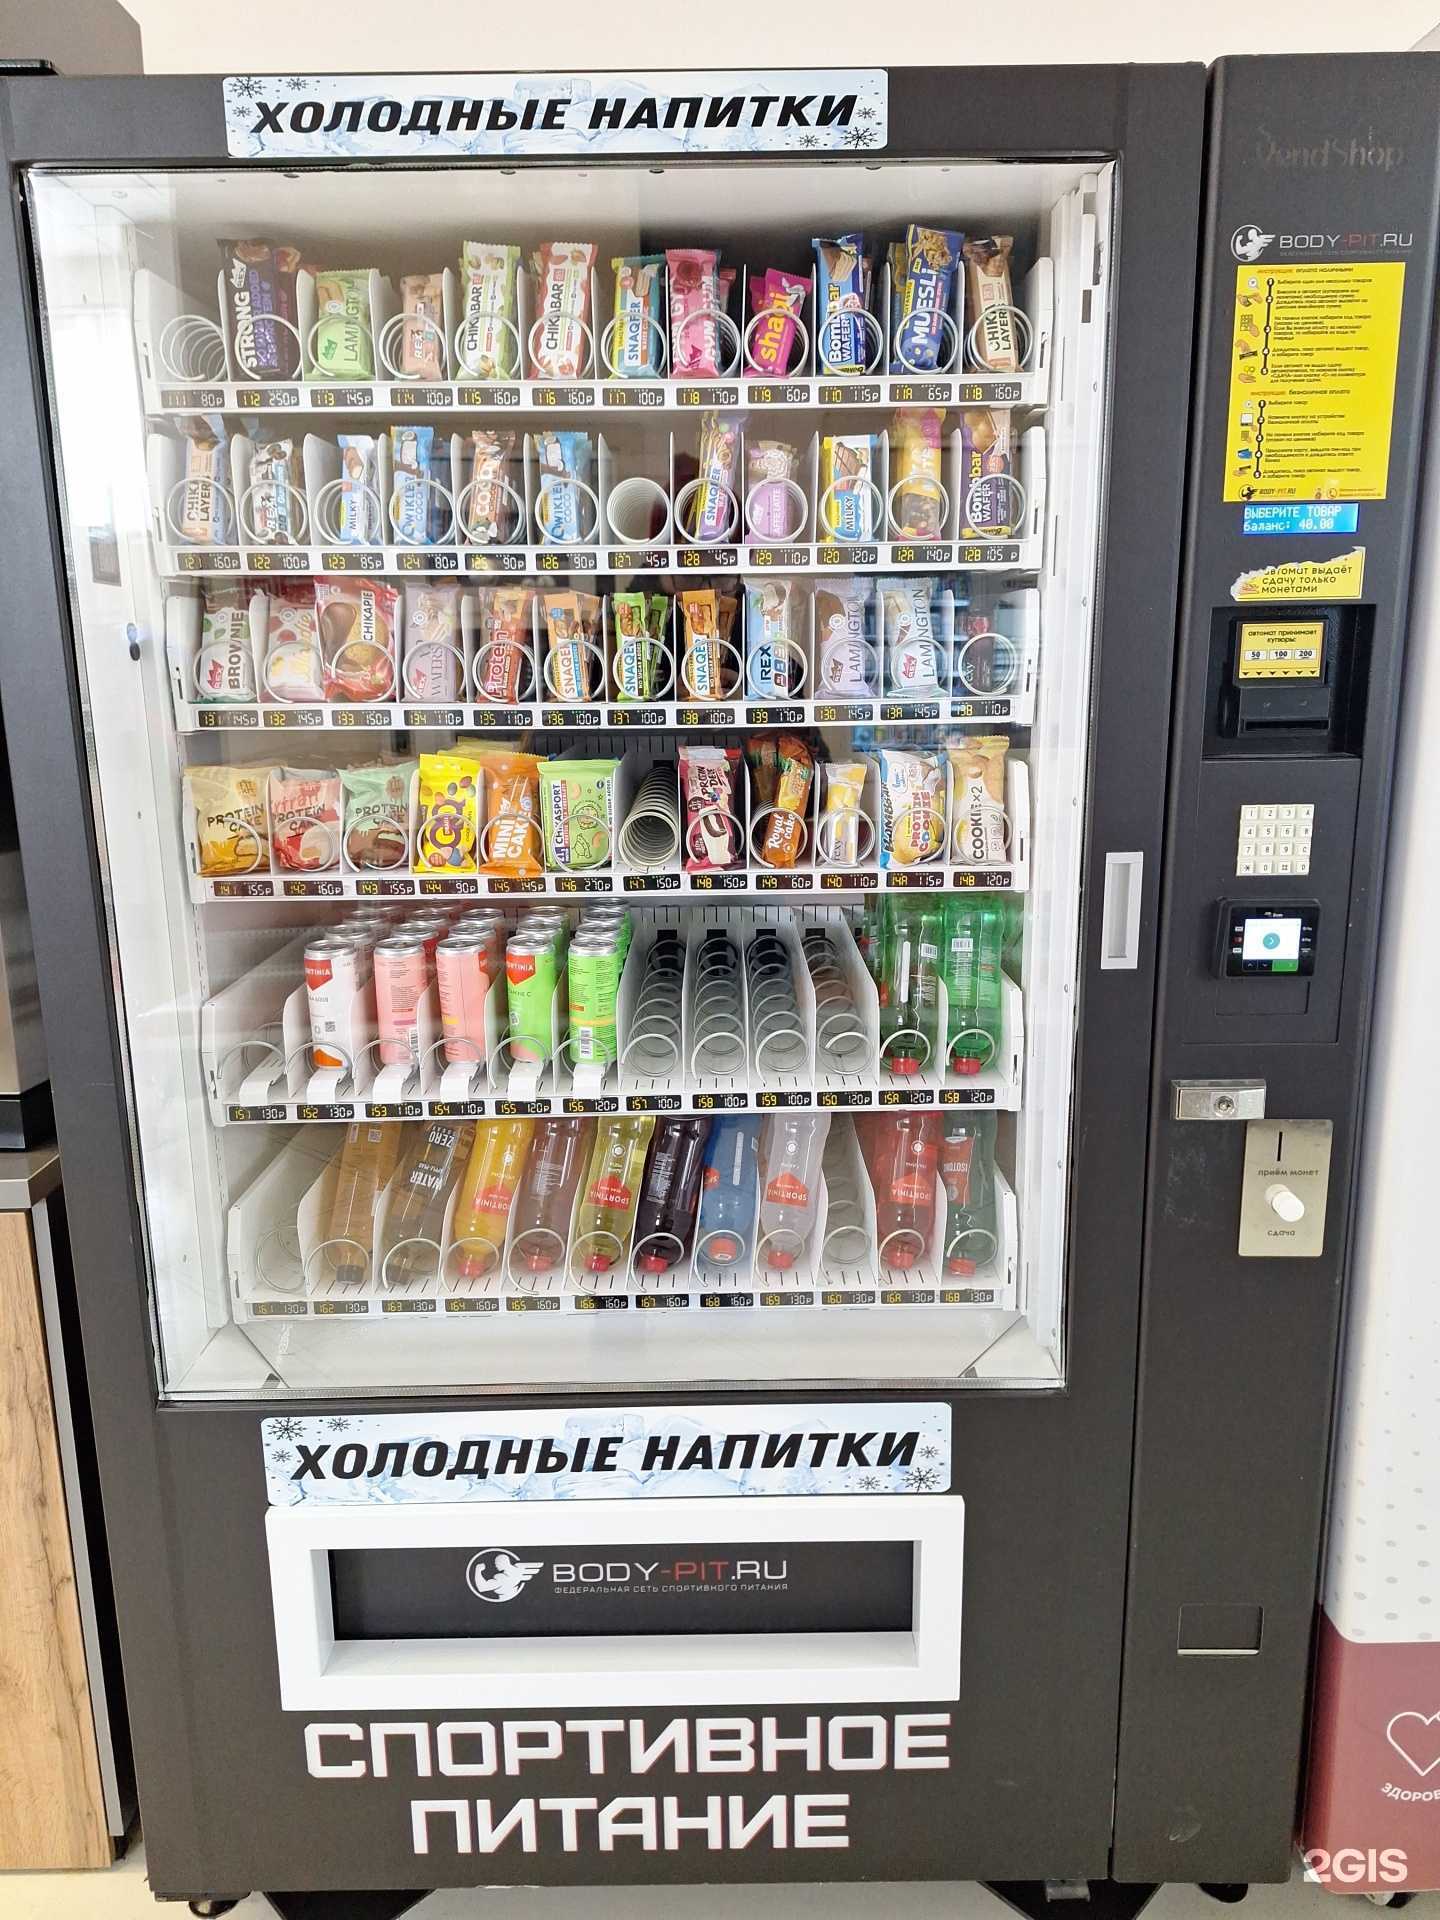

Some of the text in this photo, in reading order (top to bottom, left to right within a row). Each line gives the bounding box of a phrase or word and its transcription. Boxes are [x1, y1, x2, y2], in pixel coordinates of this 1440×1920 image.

[250, 94, 858, 137] ХОЛОДНЫЕ НАПИТКИ
[1279, 233, 1414, 249] BODY-PIT.RU
[234, 290, 258, 369] STRONG
[243, 393, 261, 407] 112
[397, 393, 415, 405] 114
[539, 392, 556, 405] 116
[683, 391, 700, 405] 118
[825, 389, 842, 403] 110
[965, 387, 983, 401] 11B
[845, 495, 855, 531] MILKY
[1243, 505, 1342, 520] ВЫБЕРИТЕ ТОВАР
[328, 557, 346, 570] 123
[542, 557, 559, 570] 126
[683, 553, 700, 566] 128
[823, 551, 840, 566] 120
[1312, 564, 1353, 576] выдаёт
[1262, 575, 1336, 587] сдачу только
[1262, 586, 1318, 595] монетами
[912, 588, 935, 678] LAMINGTON
[228, 611, 245, 690] BROWNIE
[1274, 650, 1288, 658] 100
[1299, 649, 1313, 657] 200
[759, 645, 773, 682] REX
[338, 713, 355, 726] 133
[479, 713, 496, 726] 135
[613, 712, 630, 725] 137
[752, 711, 769, 724] 139
[887, 707, 903, 719] 13A
[207, 803, 264, 828] PROTEIN
[494, 881, 510, 892] 145
[629, 878, 646, 889] 147
[762, 877, 778, 889] 149
[959, 875, 975, 886] 14B
[361, 883, 379, 895] 143
[632, 1098, 648, 1110] 157
[761, 1095, 777, 1106] 159
[884, 1093, 900, 1104] 15A
[371, 1105, 387, 1117] 153
[501, 1103, 517, 1114] 155
[428, 1130, 456, 1149] ZERO
[290, 1430, 921, 1481] ХОЛОДНЫЕ НАПИТКИ
[552, 1558, 788, 1584] BODY-PIT.RU
[554, 1582, 789, 1596] ФЕДЕРАЛЬНАЯ СЕТЬ СПОРТИВНОГО ПИТАНИЯ
[303, 1712, 952, 1779] СПОРТИВНОЕ
[410, 1793, 851, 1854] ПИТАНИЕ
